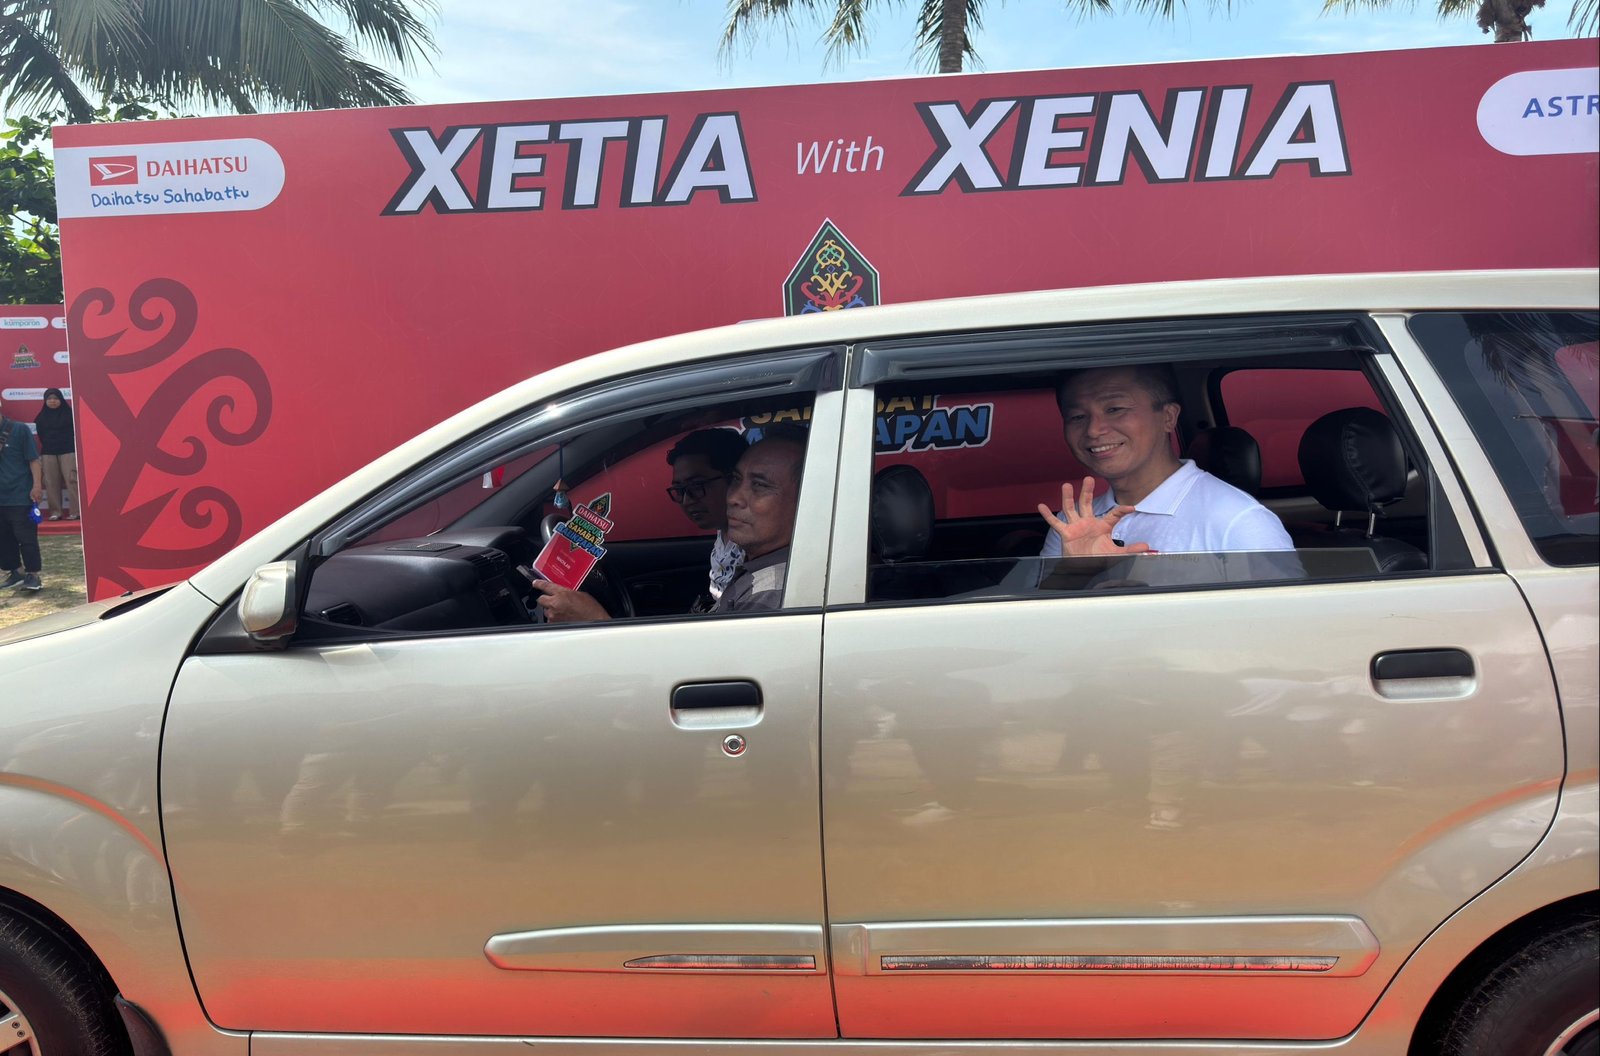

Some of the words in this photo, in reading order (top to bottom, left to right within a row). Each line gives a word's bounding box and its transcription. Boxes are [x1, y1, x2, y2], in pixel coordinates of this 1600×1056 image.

[386, 110, 756, 214] XETIA
[796, 136, 885, 175] With
[906, 82, 1350, 195] XENIA
[146, 156, 248, 177] DAIHATSU
[91, 189, 160, 208] Daihatsu
[163, 186, 250, 204] Sahabatku
[578, 505, 609, 531] DAIHATSU
[567, 521, 603, 546] SAHABAT
